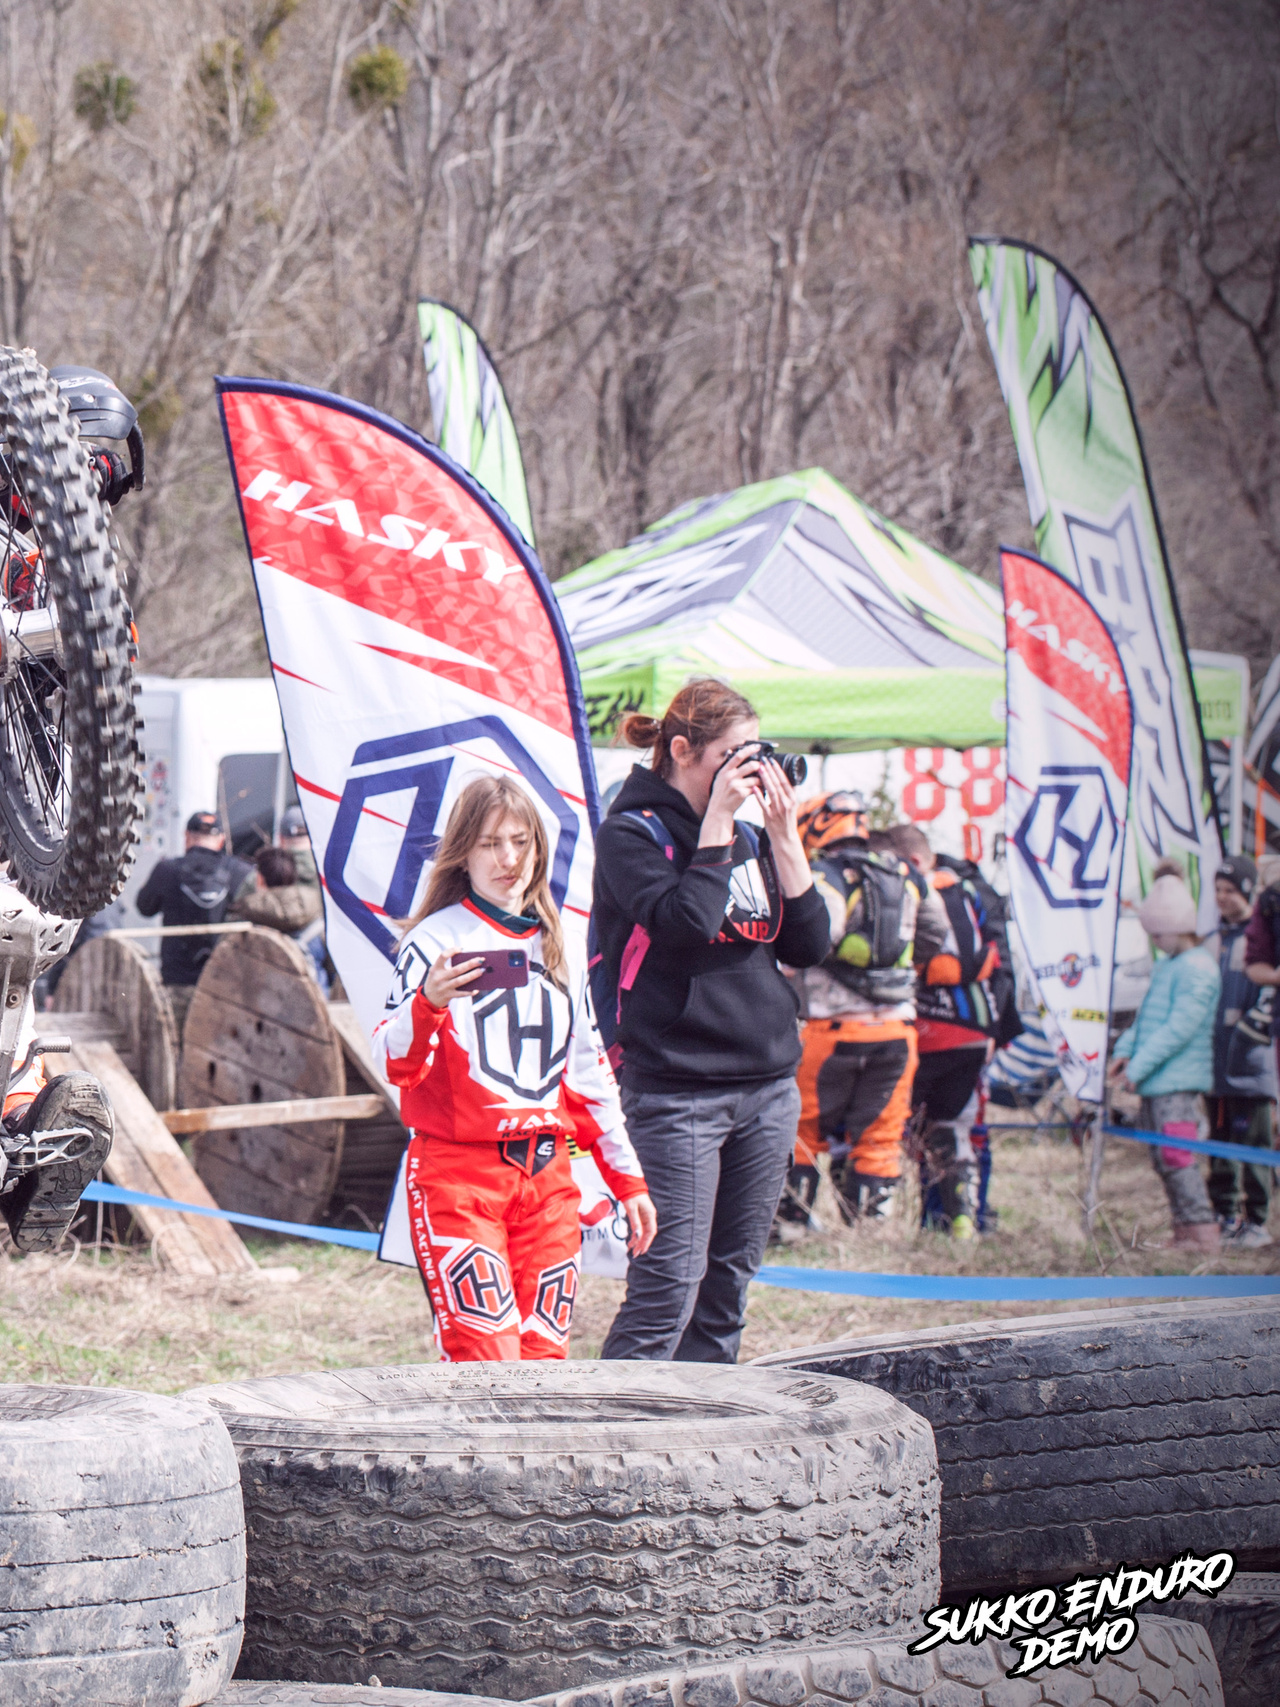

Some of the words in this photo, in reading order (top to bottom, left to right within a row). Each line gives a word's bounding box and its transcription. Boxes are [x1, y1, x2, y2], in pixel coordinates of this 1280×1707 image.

[242, 468, 525, 585] HASKY
[1007, 600, 1125, 694] HASKY
[408, 1157, 422, 1210] HASKY
[414, 1218, 437, 1280] RACING
[431, 1288, 451, 1330] TEAM
[376, 1373, 419, 1381] RADIAL
[427, 1370, 450, 1378] ALL
